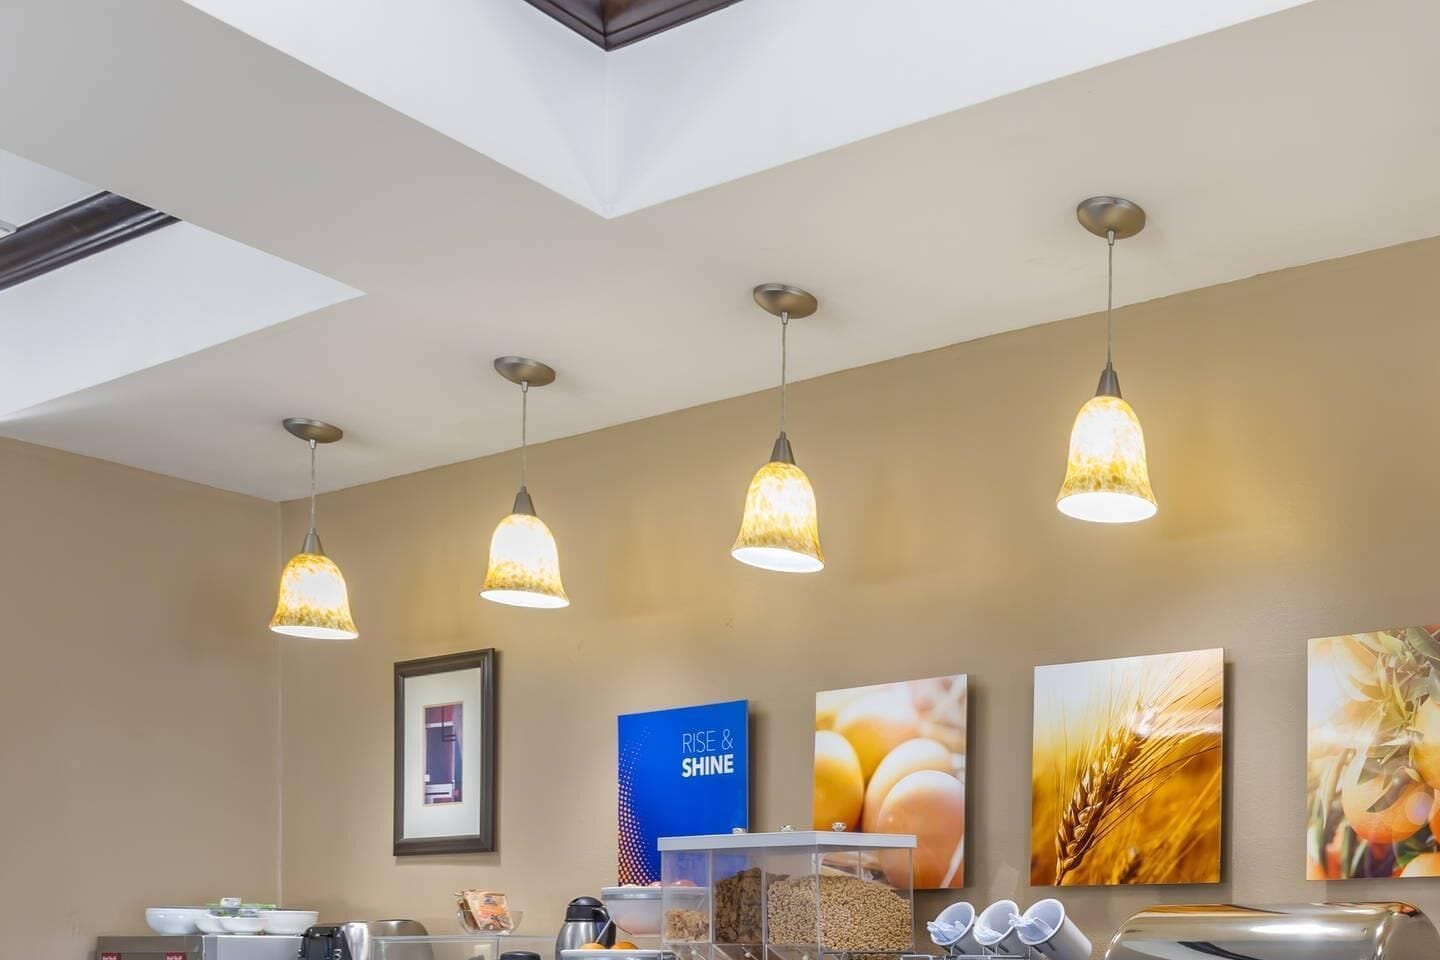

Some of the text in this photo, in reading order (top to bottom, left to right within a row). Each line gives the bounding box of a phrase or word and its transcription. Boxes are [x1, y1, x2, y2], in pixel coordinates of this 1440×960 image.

[682, 728, 734, 753] RISE &
[681, 753, 734, 778] SHINE
